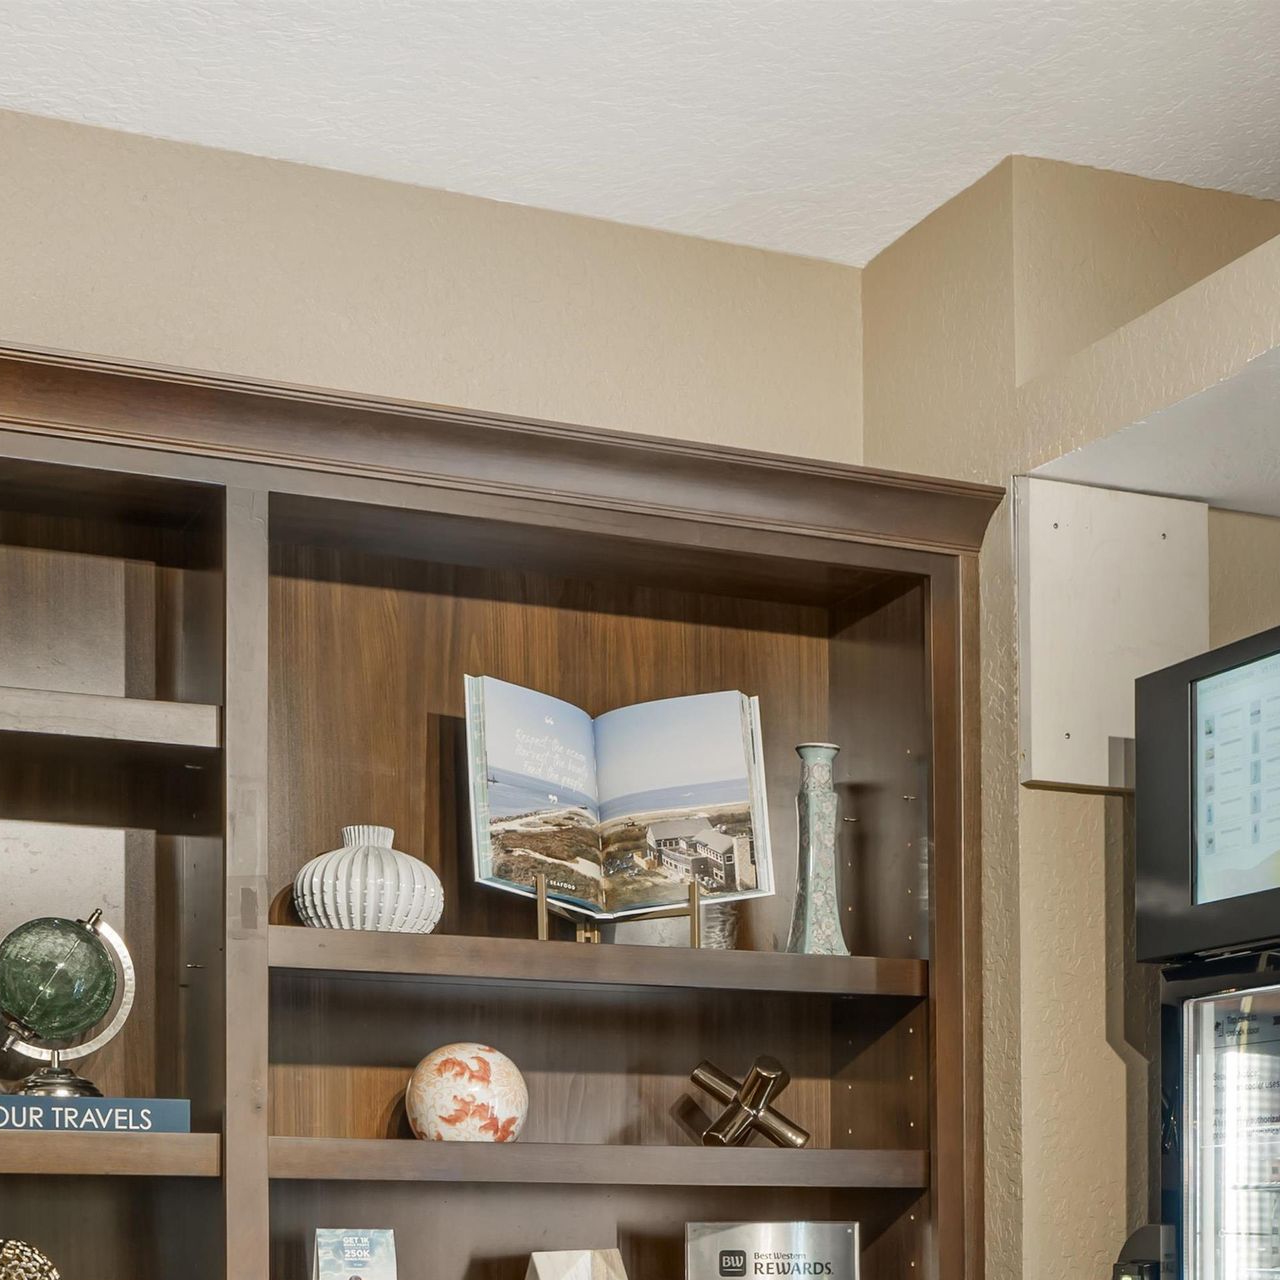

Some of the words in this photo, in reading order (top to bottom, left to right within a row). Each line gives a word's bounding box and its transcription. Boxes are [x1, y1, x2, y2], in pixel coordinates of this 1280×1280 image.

[549, 879, 577, 891] SEAFOOD
[51, 1107, 152, 1131] TRAVELS
[345, 1250, 370, 1258] 250K
[754, 1252, 772, 1260] Best
[773, 1252, 807, 1260] Western
[722, 1255, 744, 1268] BW
